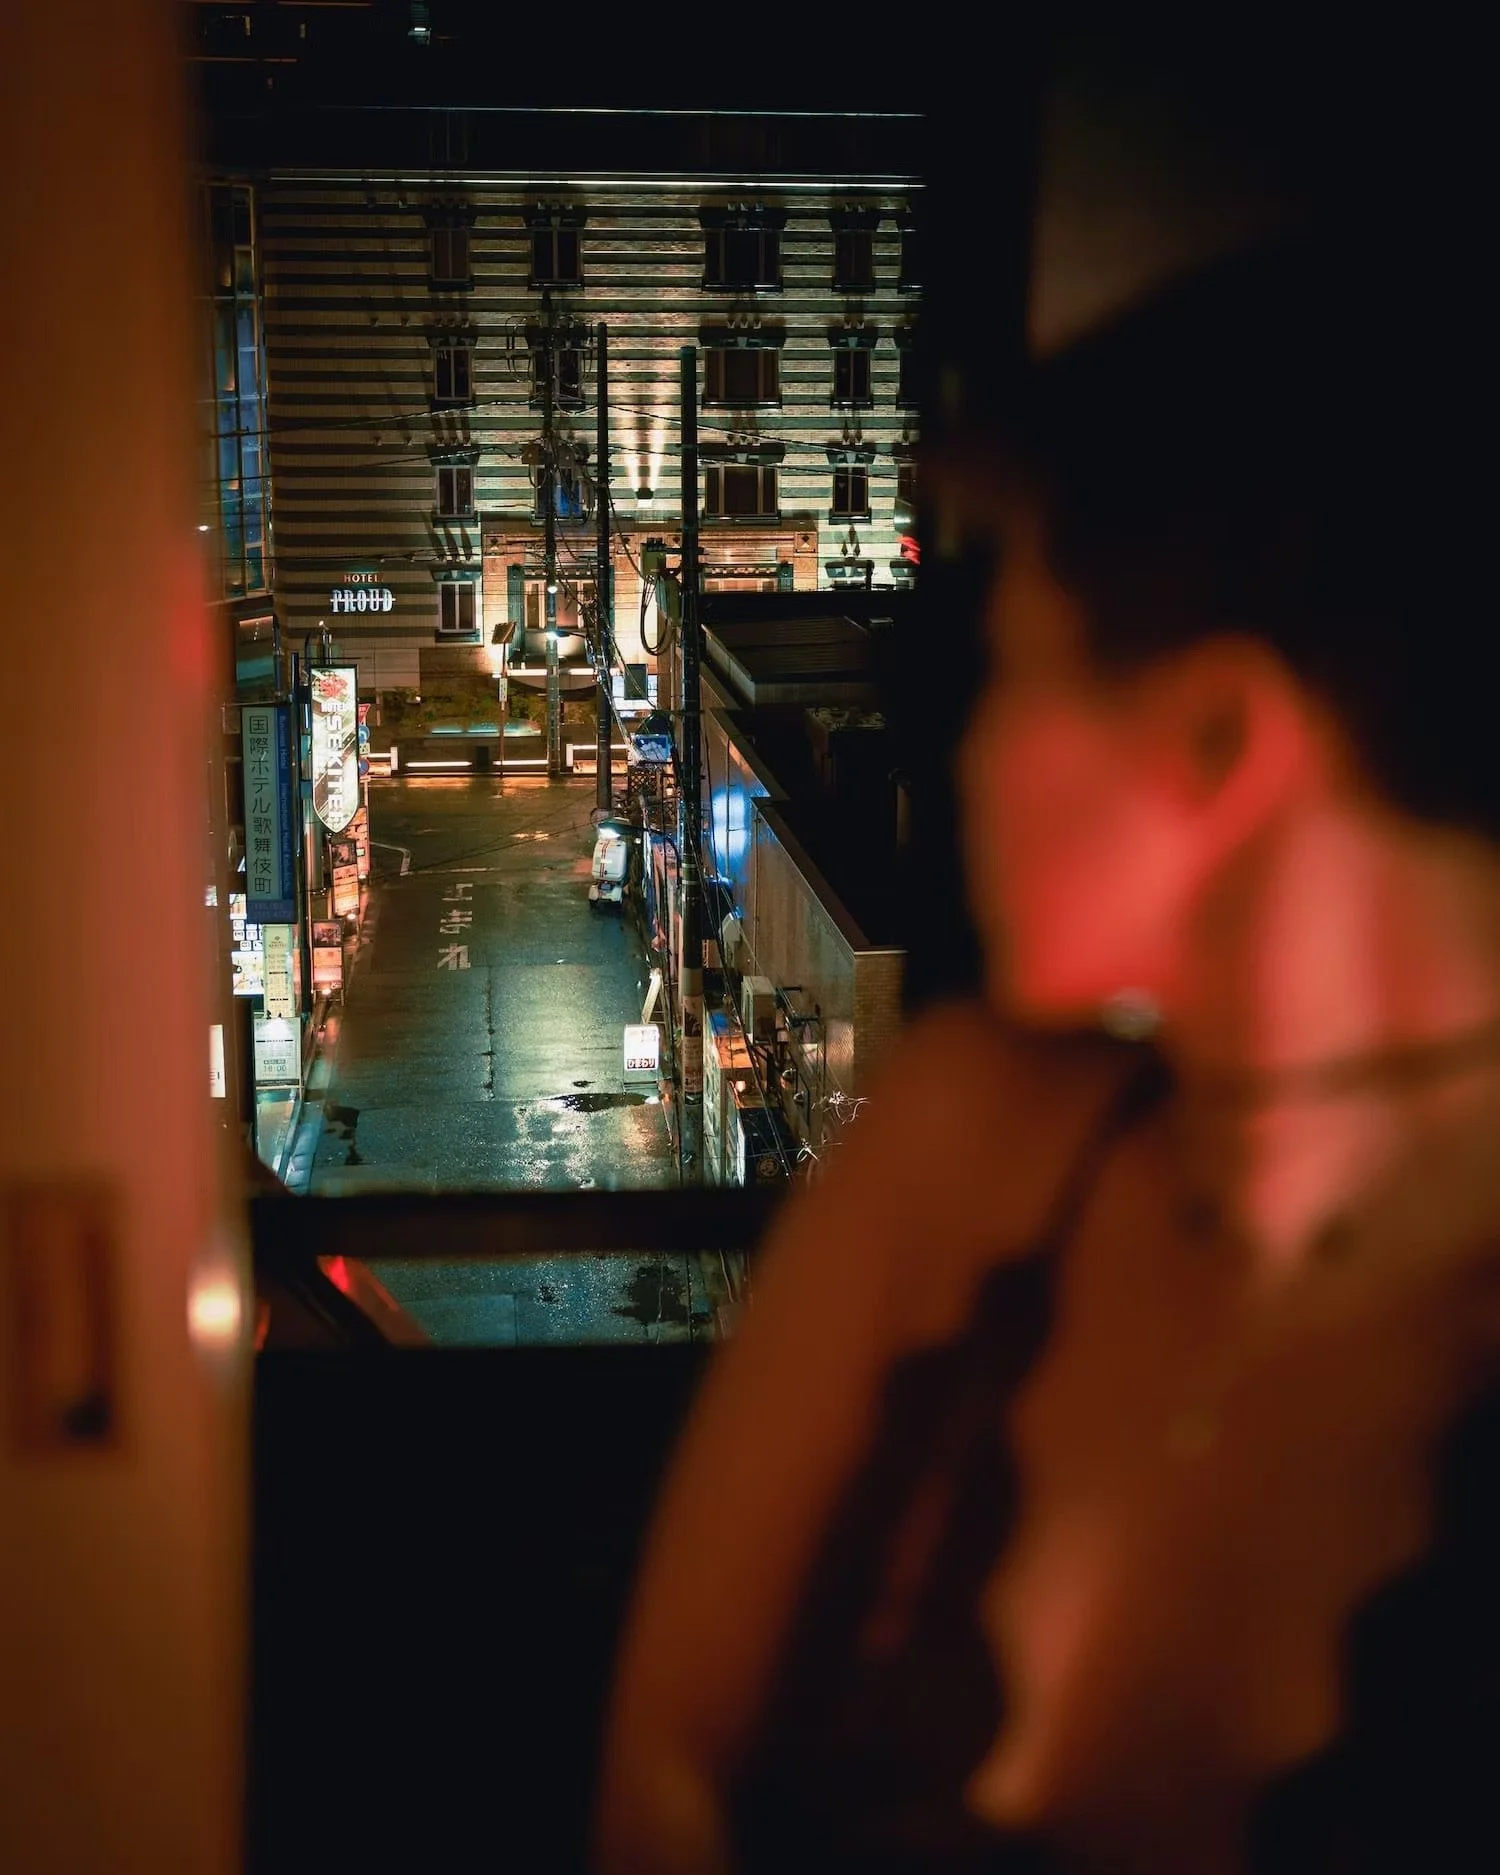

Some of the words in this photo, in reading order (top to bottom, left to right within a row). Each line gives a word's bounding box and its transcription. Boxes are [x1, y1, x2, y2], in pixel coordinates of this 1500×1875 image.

[331, 587, 394, 612] PROUD
[343, 574, 379, 583] HOTEL
[249, 715, 272, 895] 国際ホテル歌舞伎町
[327, 715, 344, 818] SEKITEI
[438, 883, 473, 971] 止まれ
